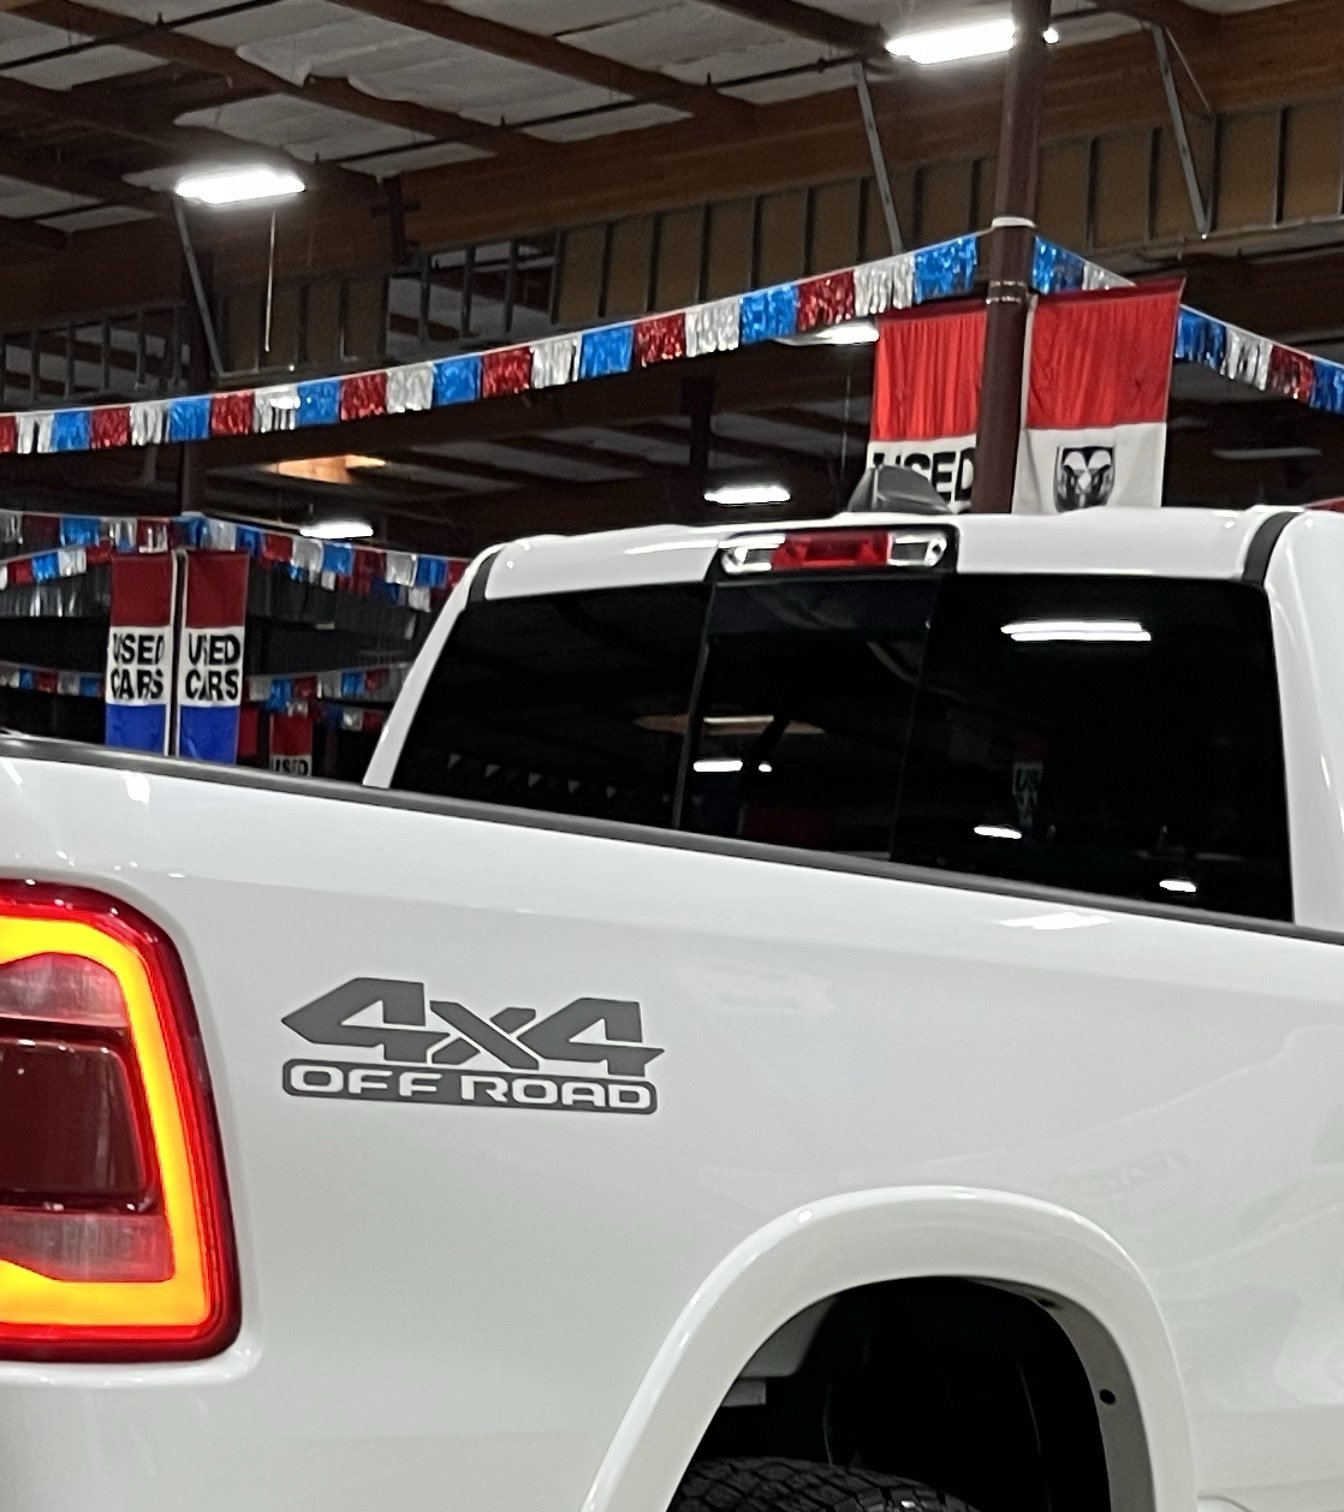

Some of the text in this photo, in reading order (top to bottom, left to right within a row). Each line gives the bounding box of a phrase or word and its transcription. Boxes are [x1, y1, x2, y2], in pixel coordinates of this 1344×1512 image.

[188, 633, 241, 666] UED
[290, 1063, 652, 1109] OFF ROAD
